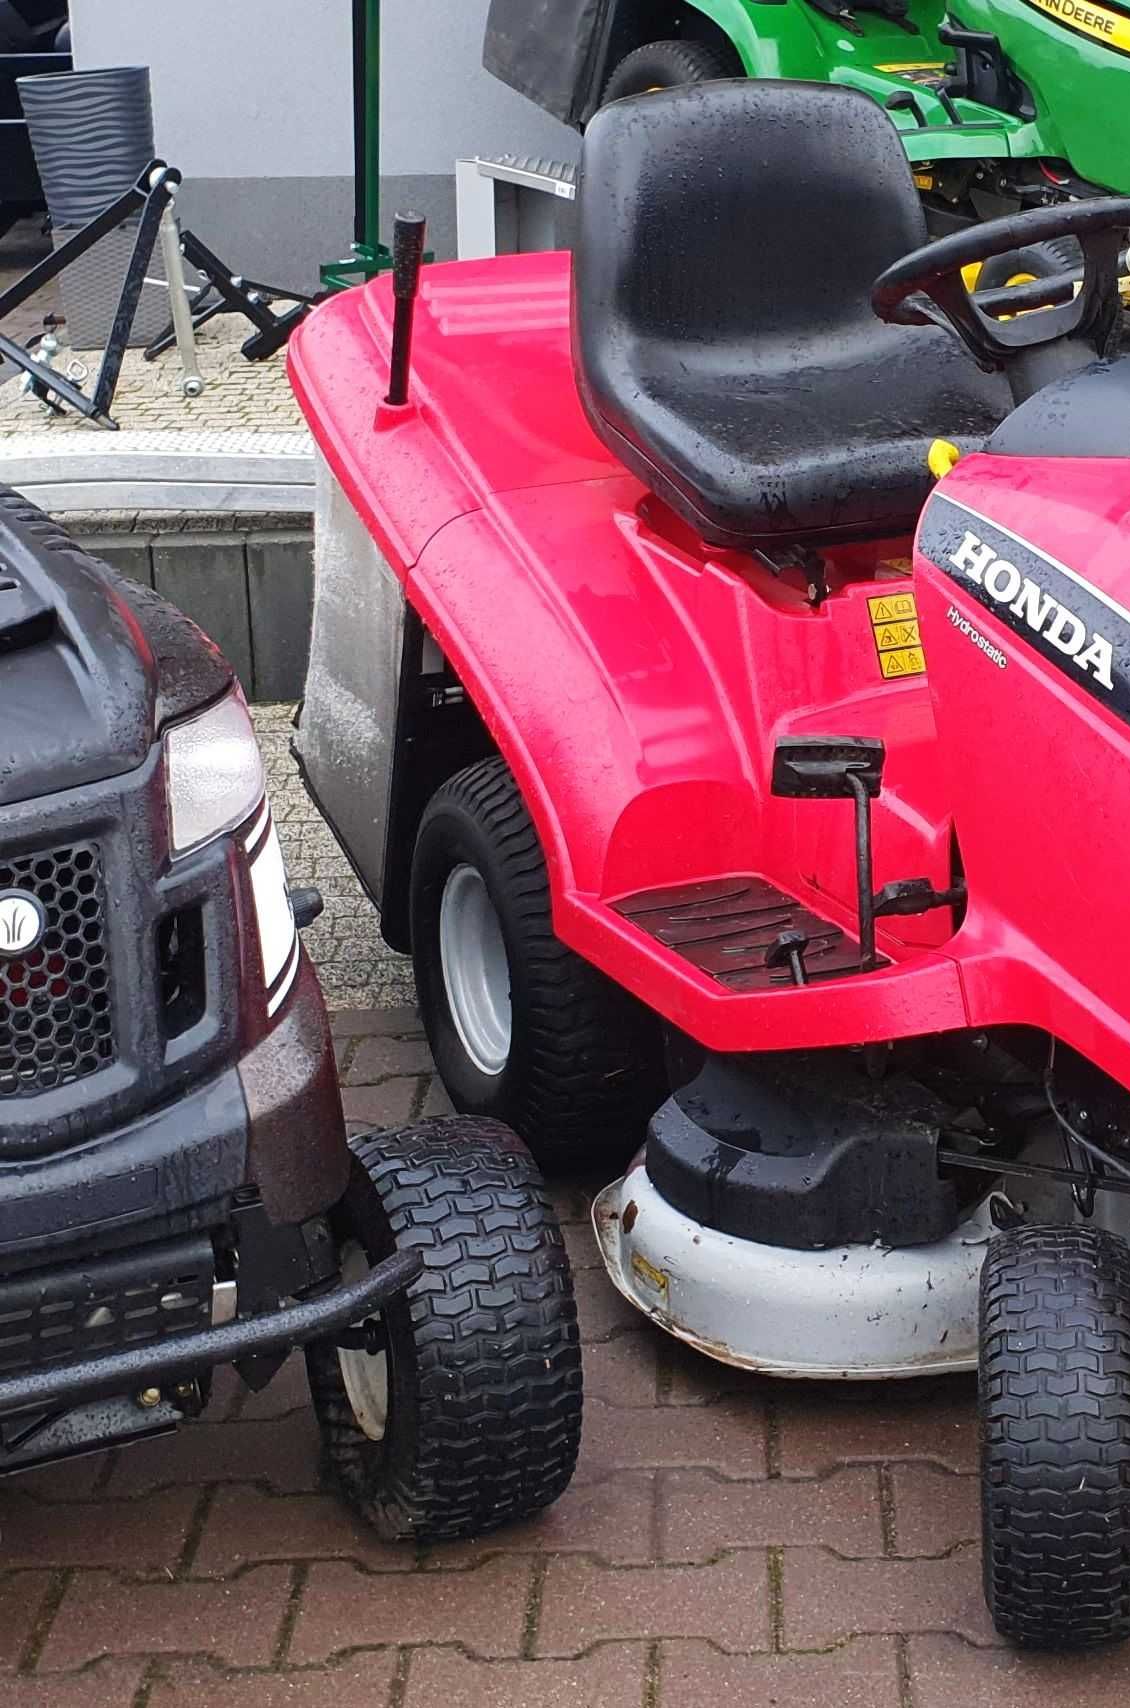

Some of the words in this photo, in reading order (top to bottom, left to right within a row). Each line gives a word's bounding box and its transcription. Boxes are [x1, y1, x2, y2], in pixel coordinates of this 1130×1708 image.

[1061, 0, 1115, 35] DEERE
[946, 605, 1008, 669] Hydrostatic
[949, 531, 1115, 691] HONDA
